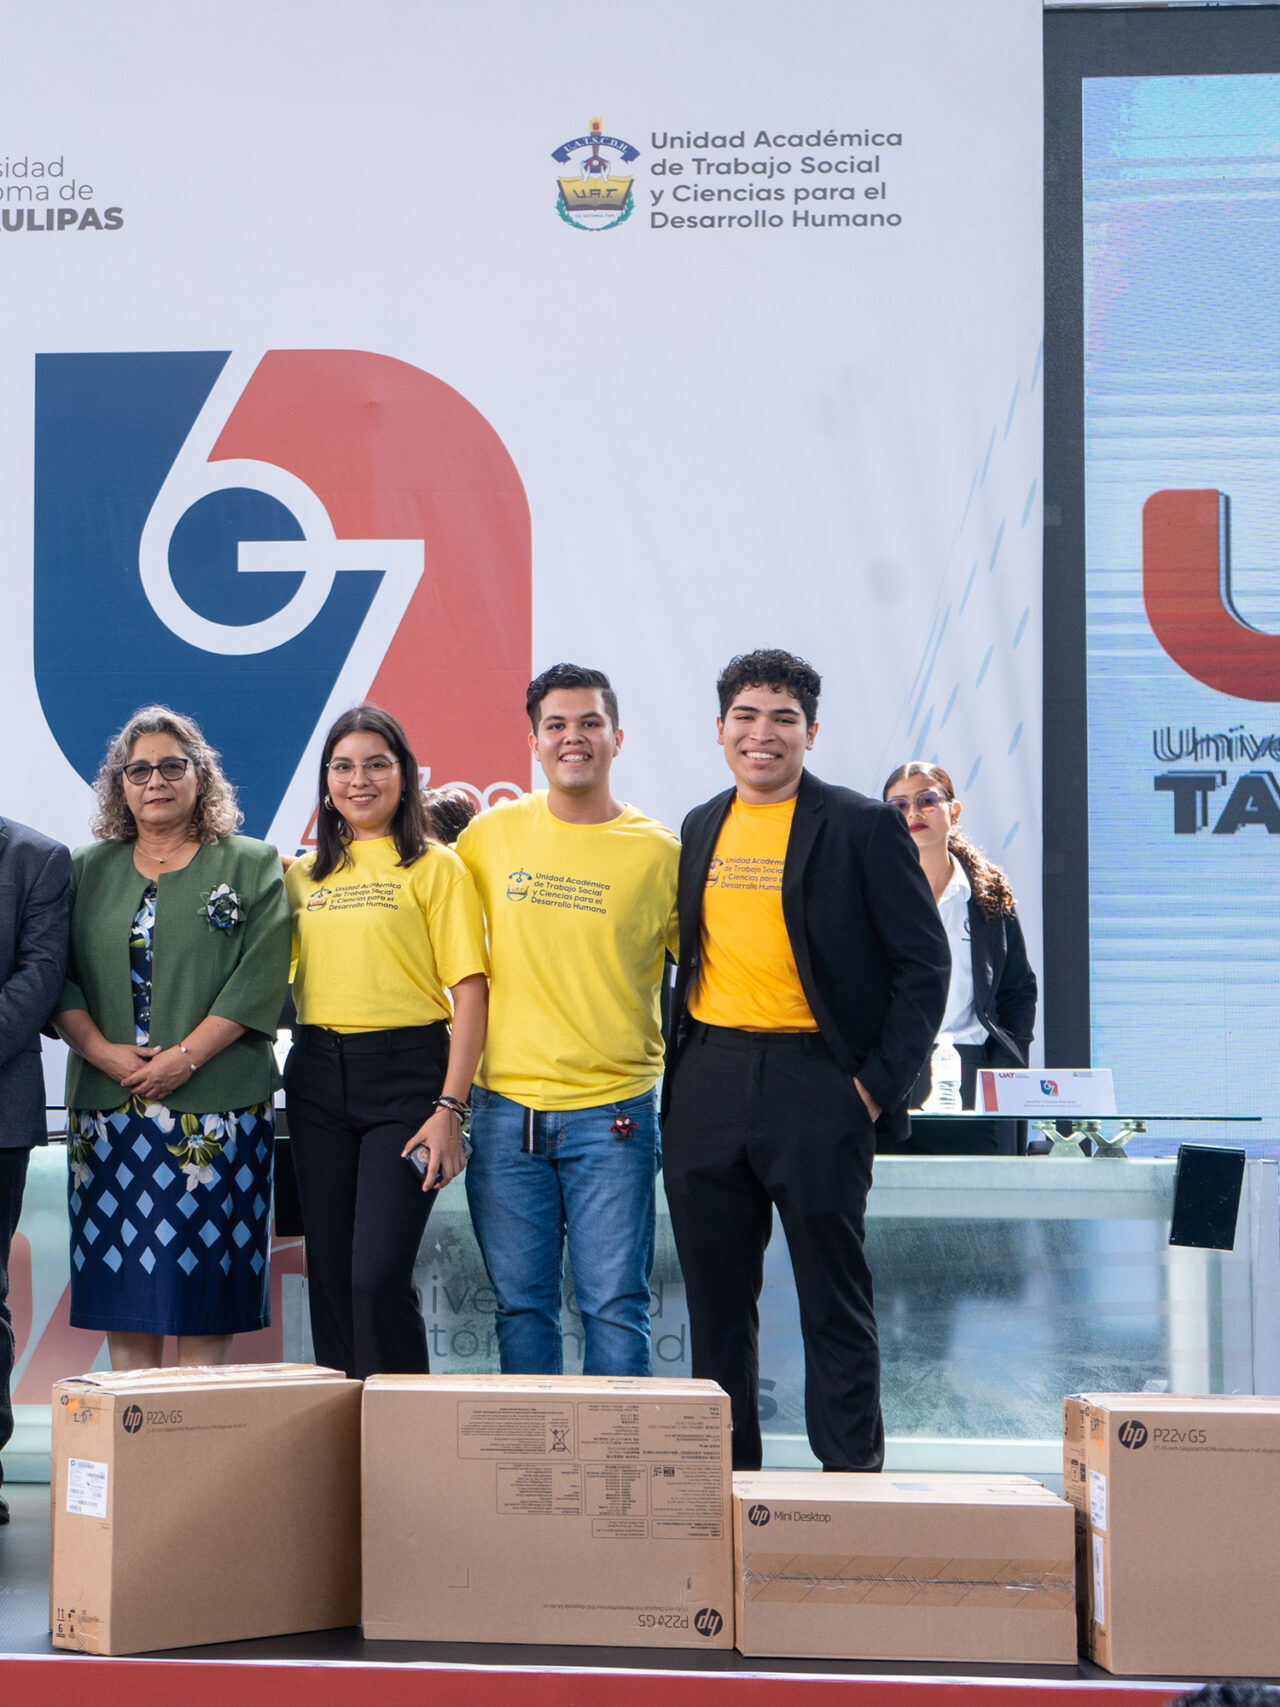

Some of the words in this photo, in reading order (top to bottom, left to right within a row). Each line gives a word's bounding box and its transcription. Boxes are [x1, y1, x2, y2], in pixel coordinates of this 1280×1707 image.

[651, 131, 745, 149] Unidad
[753, 129, 903, 149] Académica
[650, 158, 684, 176] de
[692, 157, 792, 179] Trabajo
[800, 155, 880, 174] Social
[58, 181, 94, 202] de
[650, 188, 664, 206] y
[672, 184, 786, 202] Ciencias
[794, 186, 855, 205] para
[863, 182, 886, 201] el
[651, 210, 783, 229] Desarrollo
[792, 210, 903, 228] Humano
[535, 872, 564, 882] Unidad
[539, 889, 573, 900] Ciencias
[574, 895, 594, 904] para
[546, 881, 577, 893] Trabajo
[578, 886, 602, 896] Social
[366, 901, 399, 910] Humano
[531, 896, 572, 908] Desarrollo
[573, 902, 607, 915] Humano
[123, 1404, 144, 1434] hp
[147, 1410, 169, 1424] P22v
[170, 1410, 183, 1424] G5
[1118, 1420, 1148, 1450] hp
[1154, 1428, 1186, 1442] P22v
[1188, 1429, 1207, 1443] G5
[748, 1504, 770, 1527] hp
[774, 1511, 792, 1521] Mini
[794, 1511, 832, 1523] Desktop
[638, 1614, 655, 1627] G5
[694, 1607, 723, 1637] hp
